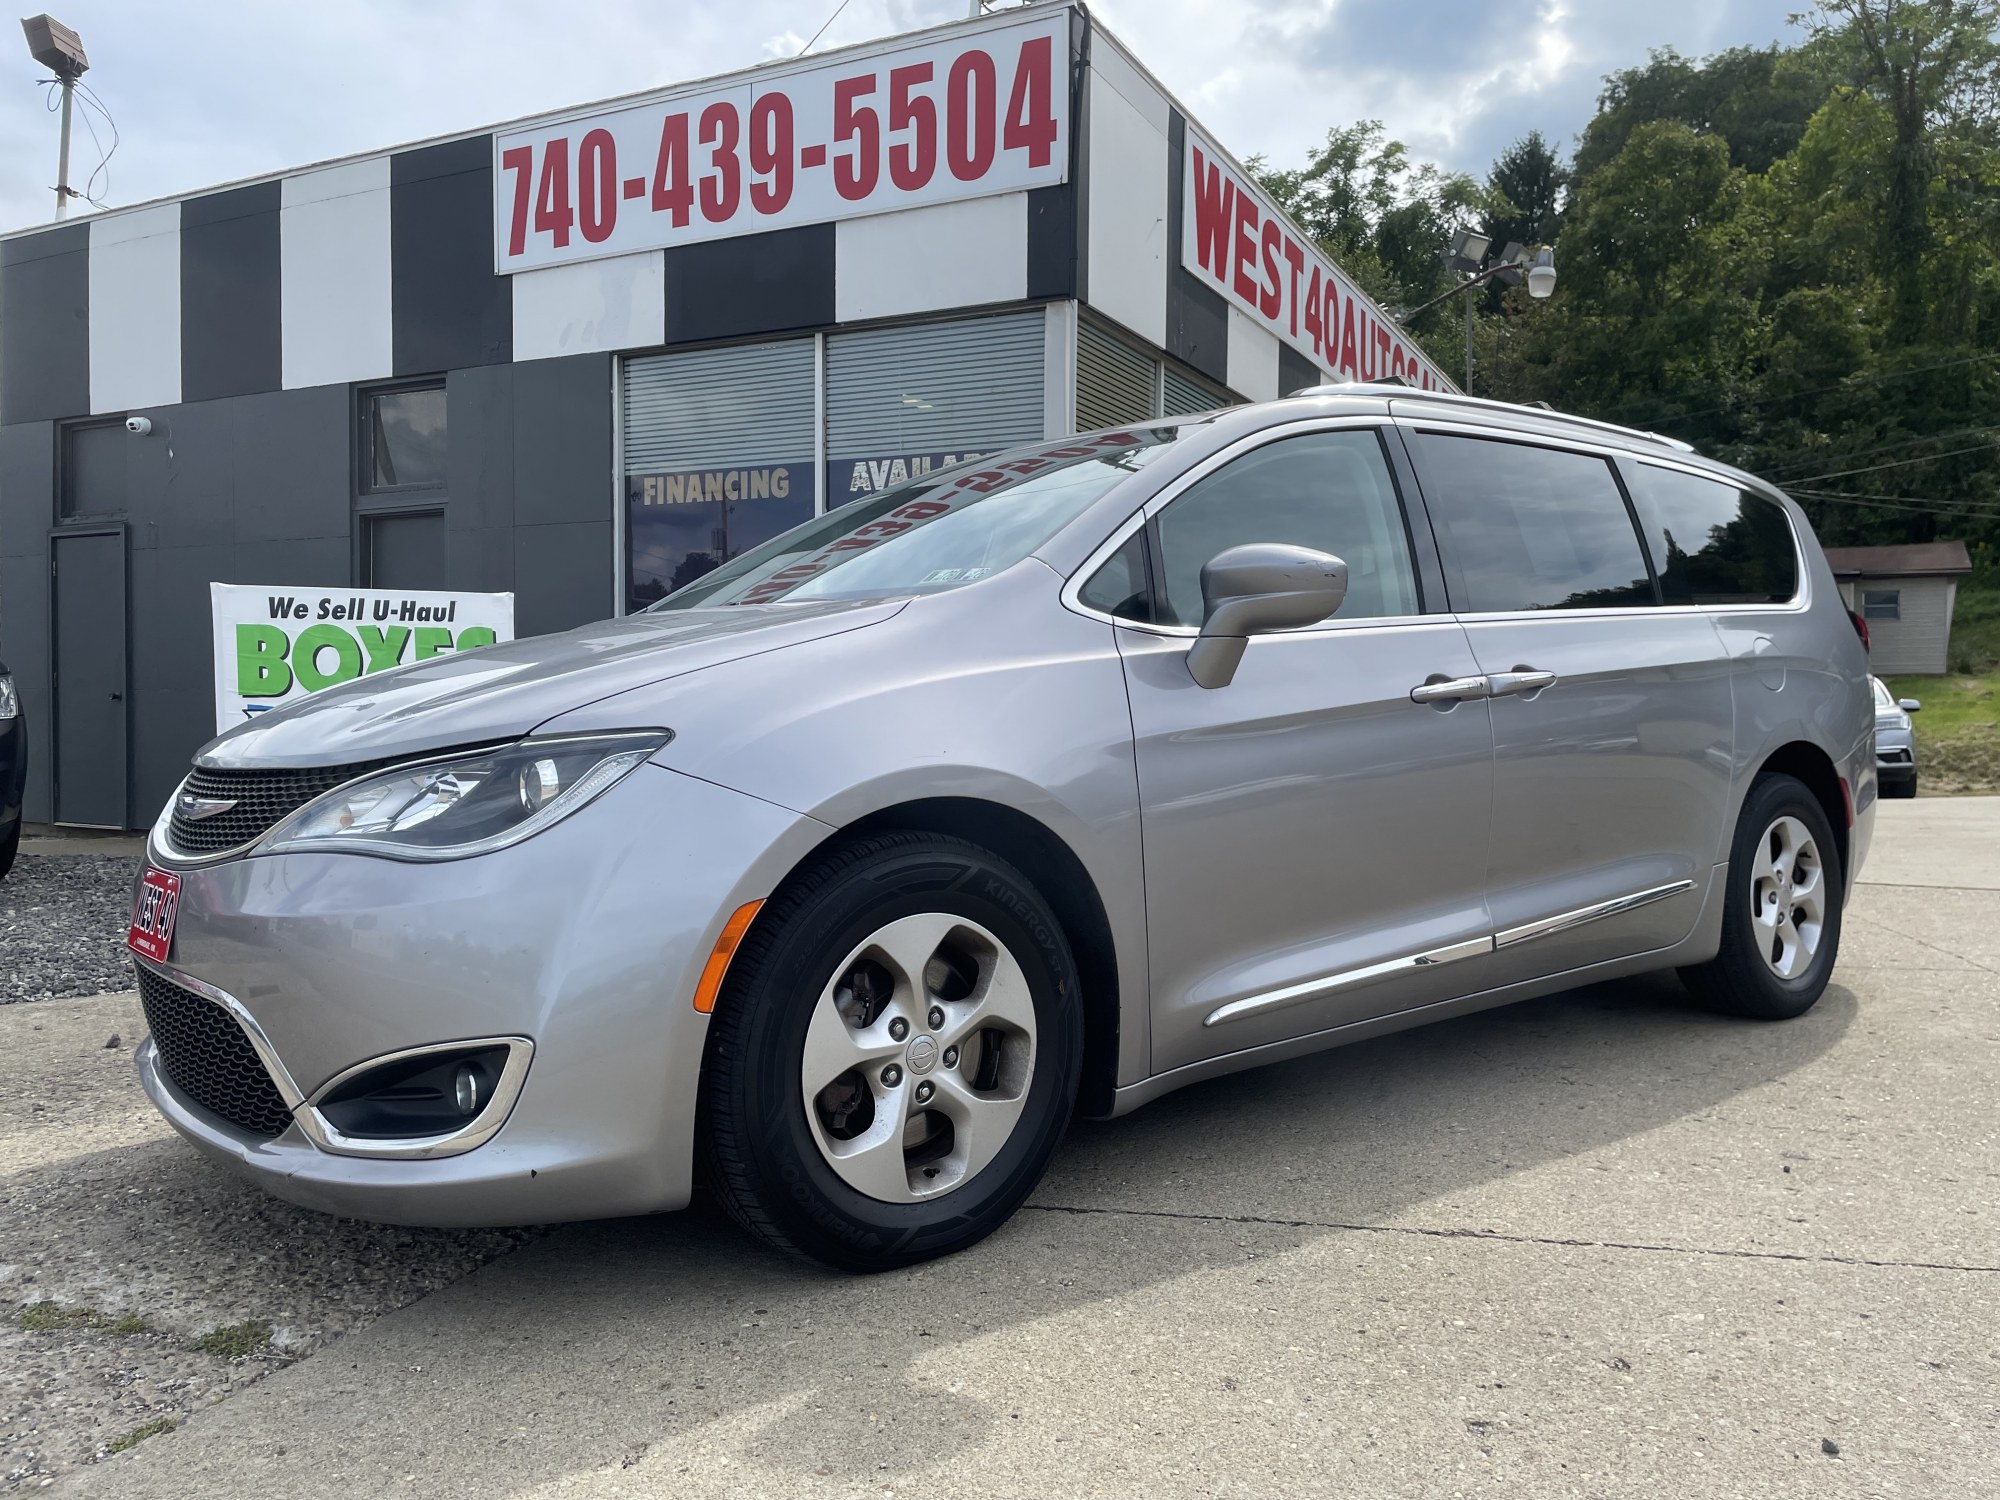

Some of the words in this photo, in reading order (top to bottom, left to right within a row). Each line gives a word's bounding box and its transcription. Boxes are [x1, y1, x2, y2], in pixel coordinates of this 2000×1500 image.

[502, 36, 1057, 257] 740-439-5504
[643, 467, 790, 505] FINANCING
[850, 452, 990, 491] AVAIL
[268, 597, 309, 619] We
[317, 598, 365, 621] Sell
[372, 600, 457, 622] U-Haul
[134, 882, 163, 935] WEST
[158, 890, 175, 941] 40
